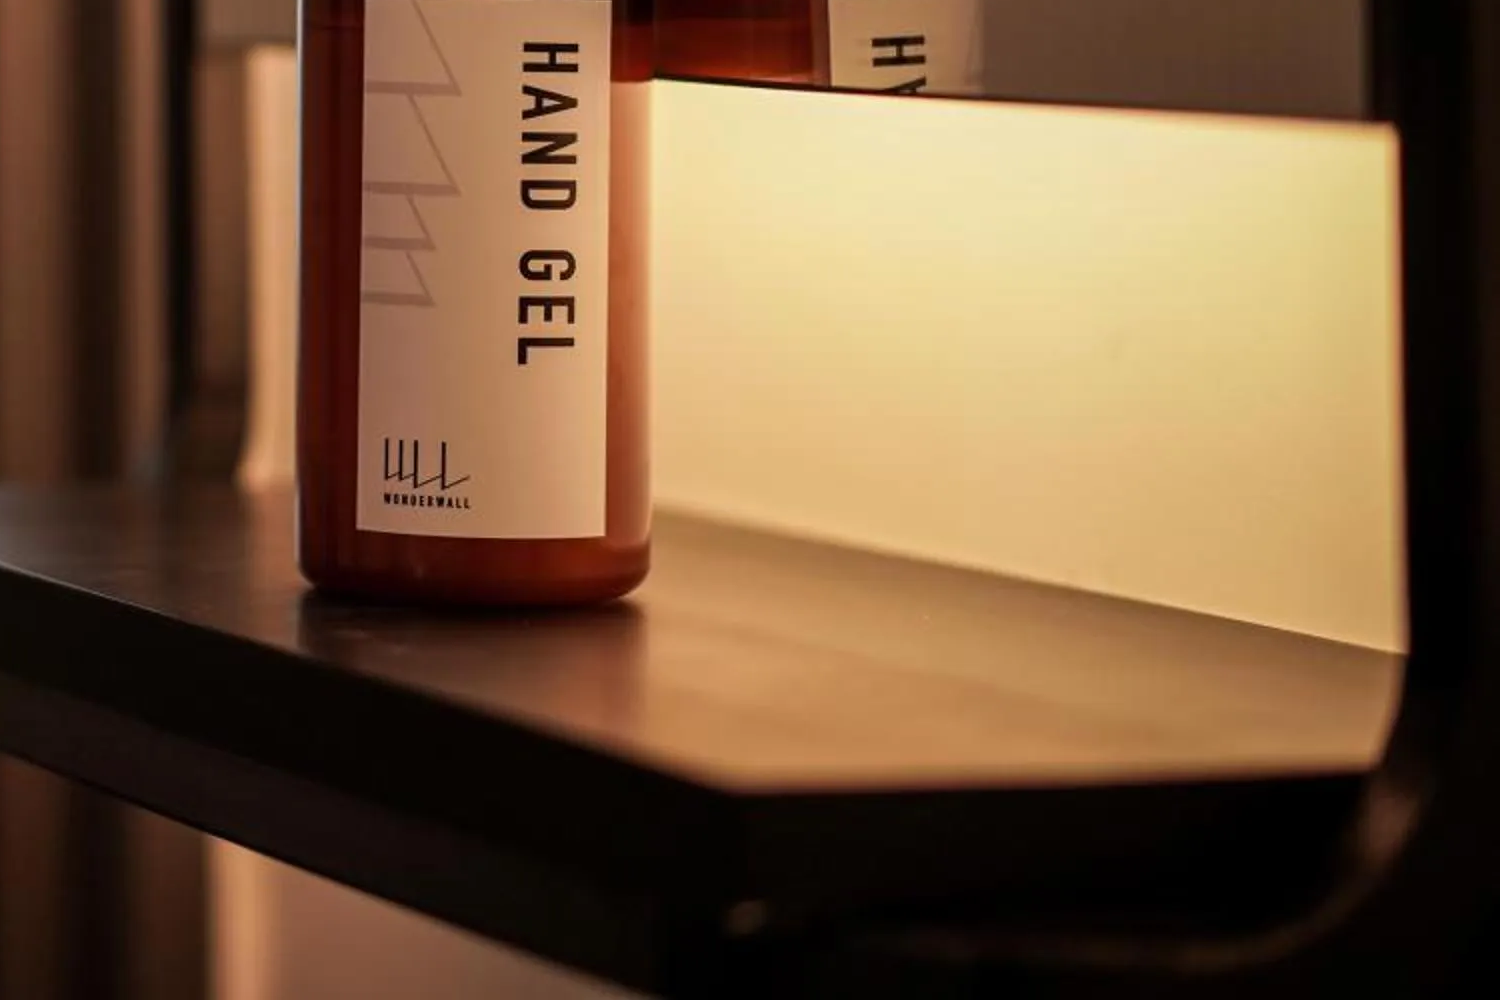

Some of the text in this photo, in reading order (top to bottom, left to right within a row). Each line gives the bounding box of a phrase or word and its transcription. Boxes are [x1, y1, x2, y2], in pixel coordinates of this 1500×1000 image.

[517, 42, 579, 365] HAND GEL
[383, 493, 471, 509] WONDERWALL
